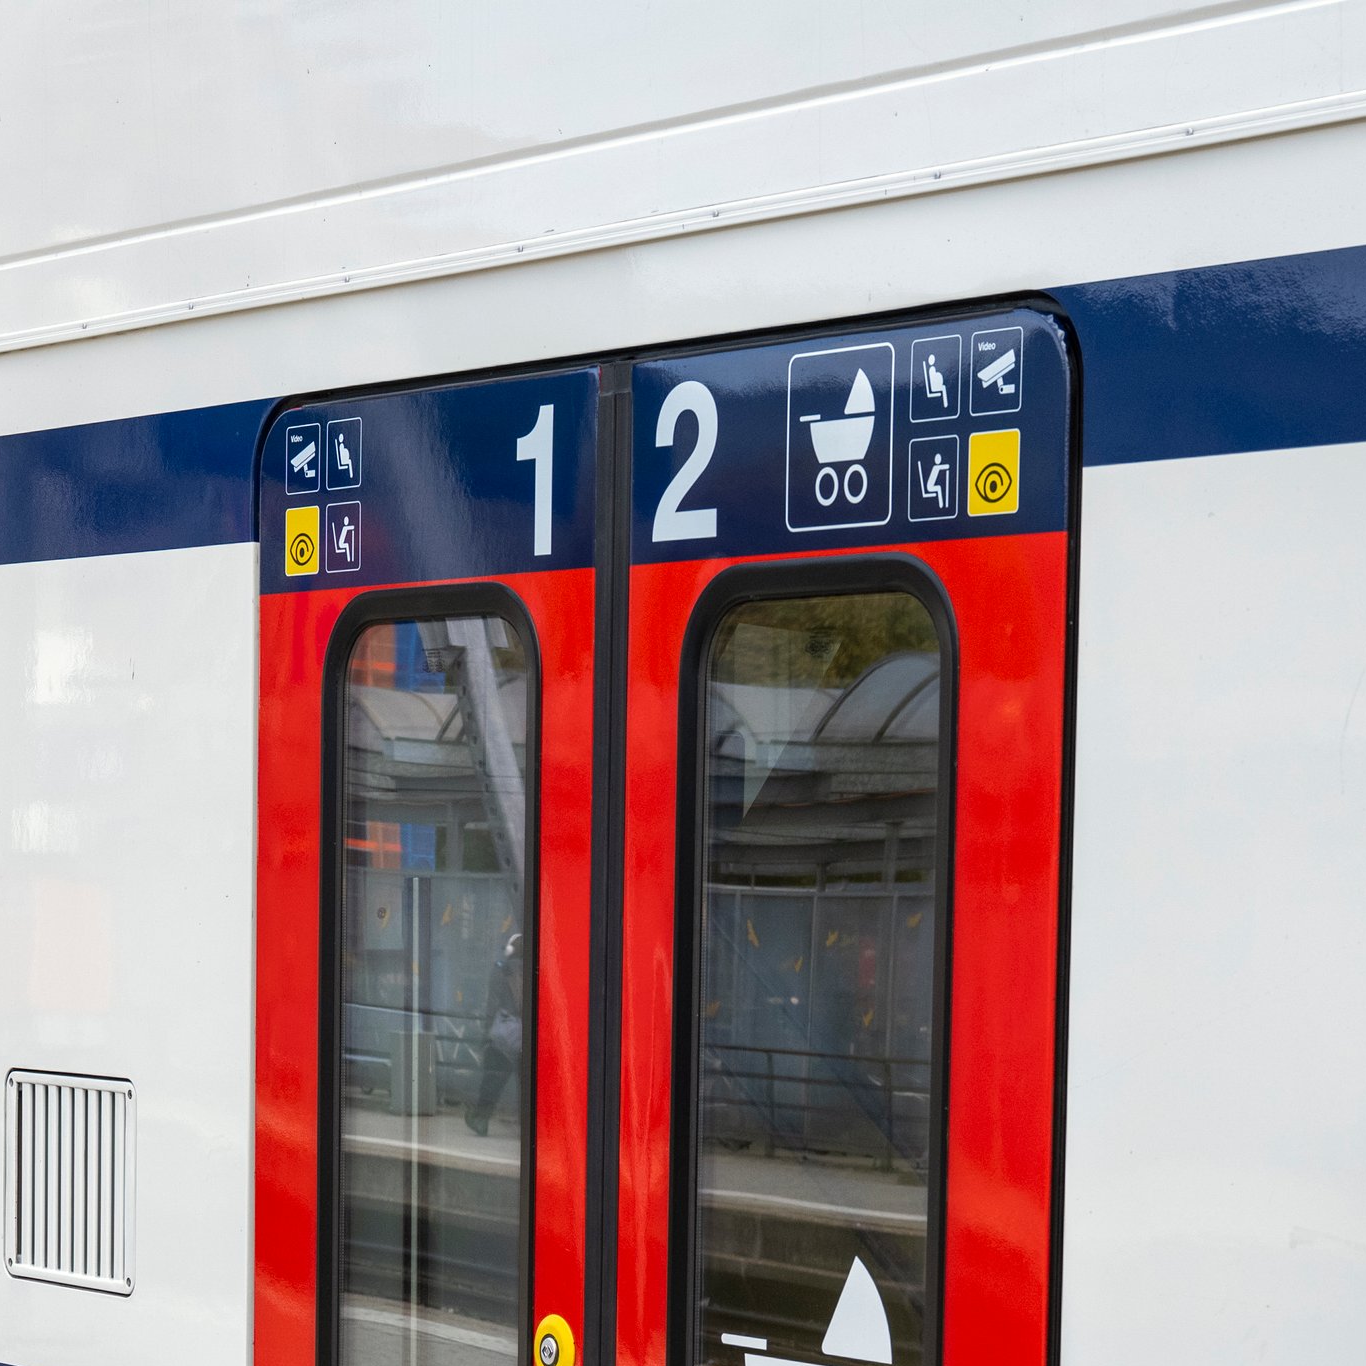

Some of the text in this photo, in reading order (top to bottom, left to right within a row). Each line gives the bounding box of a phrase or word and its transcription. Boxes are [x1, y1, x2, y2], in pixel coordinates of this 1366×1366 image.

[978, 341, 996, 351] Video
[290, 434, 303, 443] Video
[652, 381, 718, 542] 2
[516, 404, 554, 556] 1
